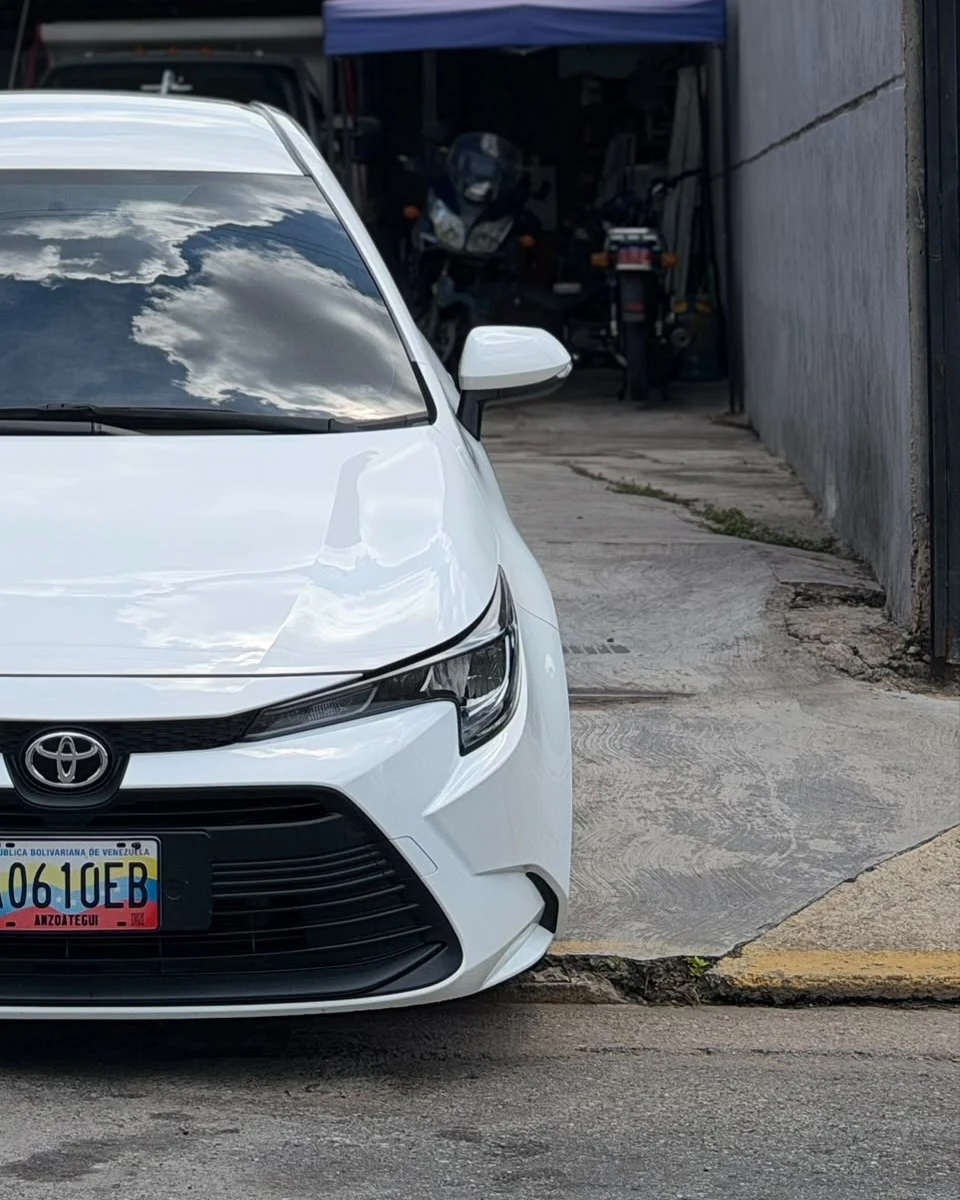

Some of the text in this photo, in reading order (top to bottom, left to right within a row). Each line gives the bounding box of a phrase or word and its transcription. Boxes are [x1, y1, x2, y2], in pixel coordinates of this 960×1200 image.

[30, 848, 86, 856] BOLIVARIANA
[89, 848, 100, 856] DE
[102, 848, 150, 856] VENEZUELA
[34, 914, 98, 926] ANZOATEGUI
